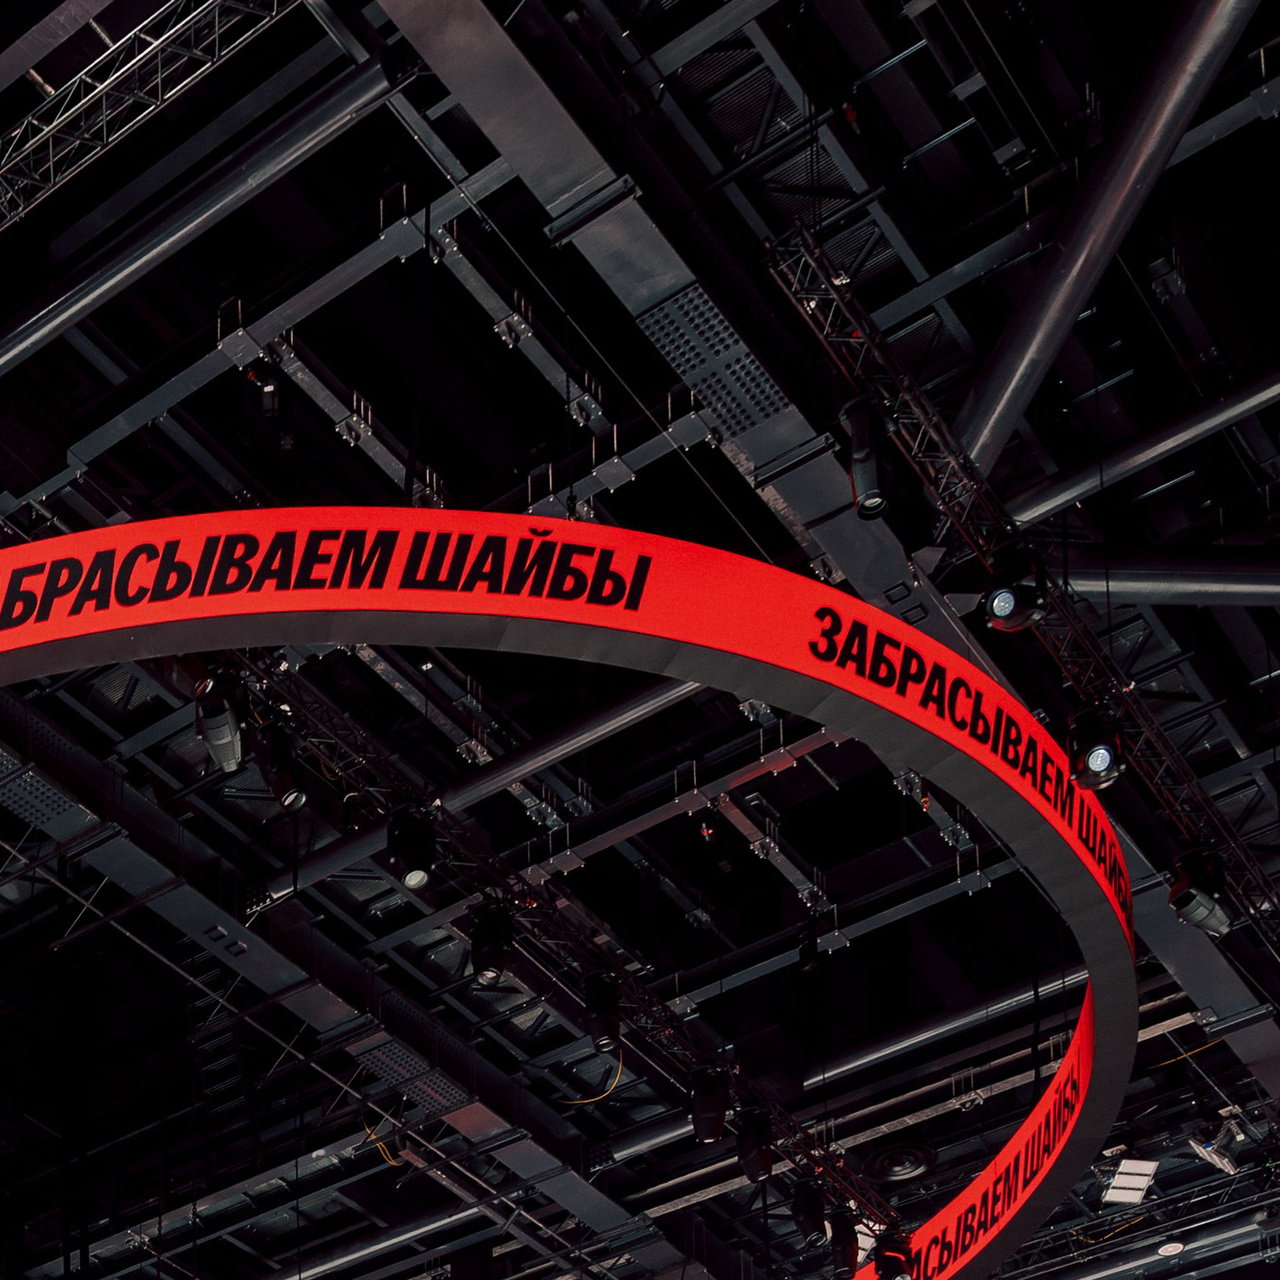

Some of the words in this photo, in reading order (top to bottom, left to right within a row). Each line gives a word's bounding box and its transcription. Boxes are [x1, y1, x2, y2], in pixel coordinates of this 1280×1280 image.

[399, 528, 652, 611] ШАЙБЫ
[809, 606, 1073, 828] ЗАБРАСЫВАЕМ
[1022, 1050, 1081, 1193] ШАЙБЫ
